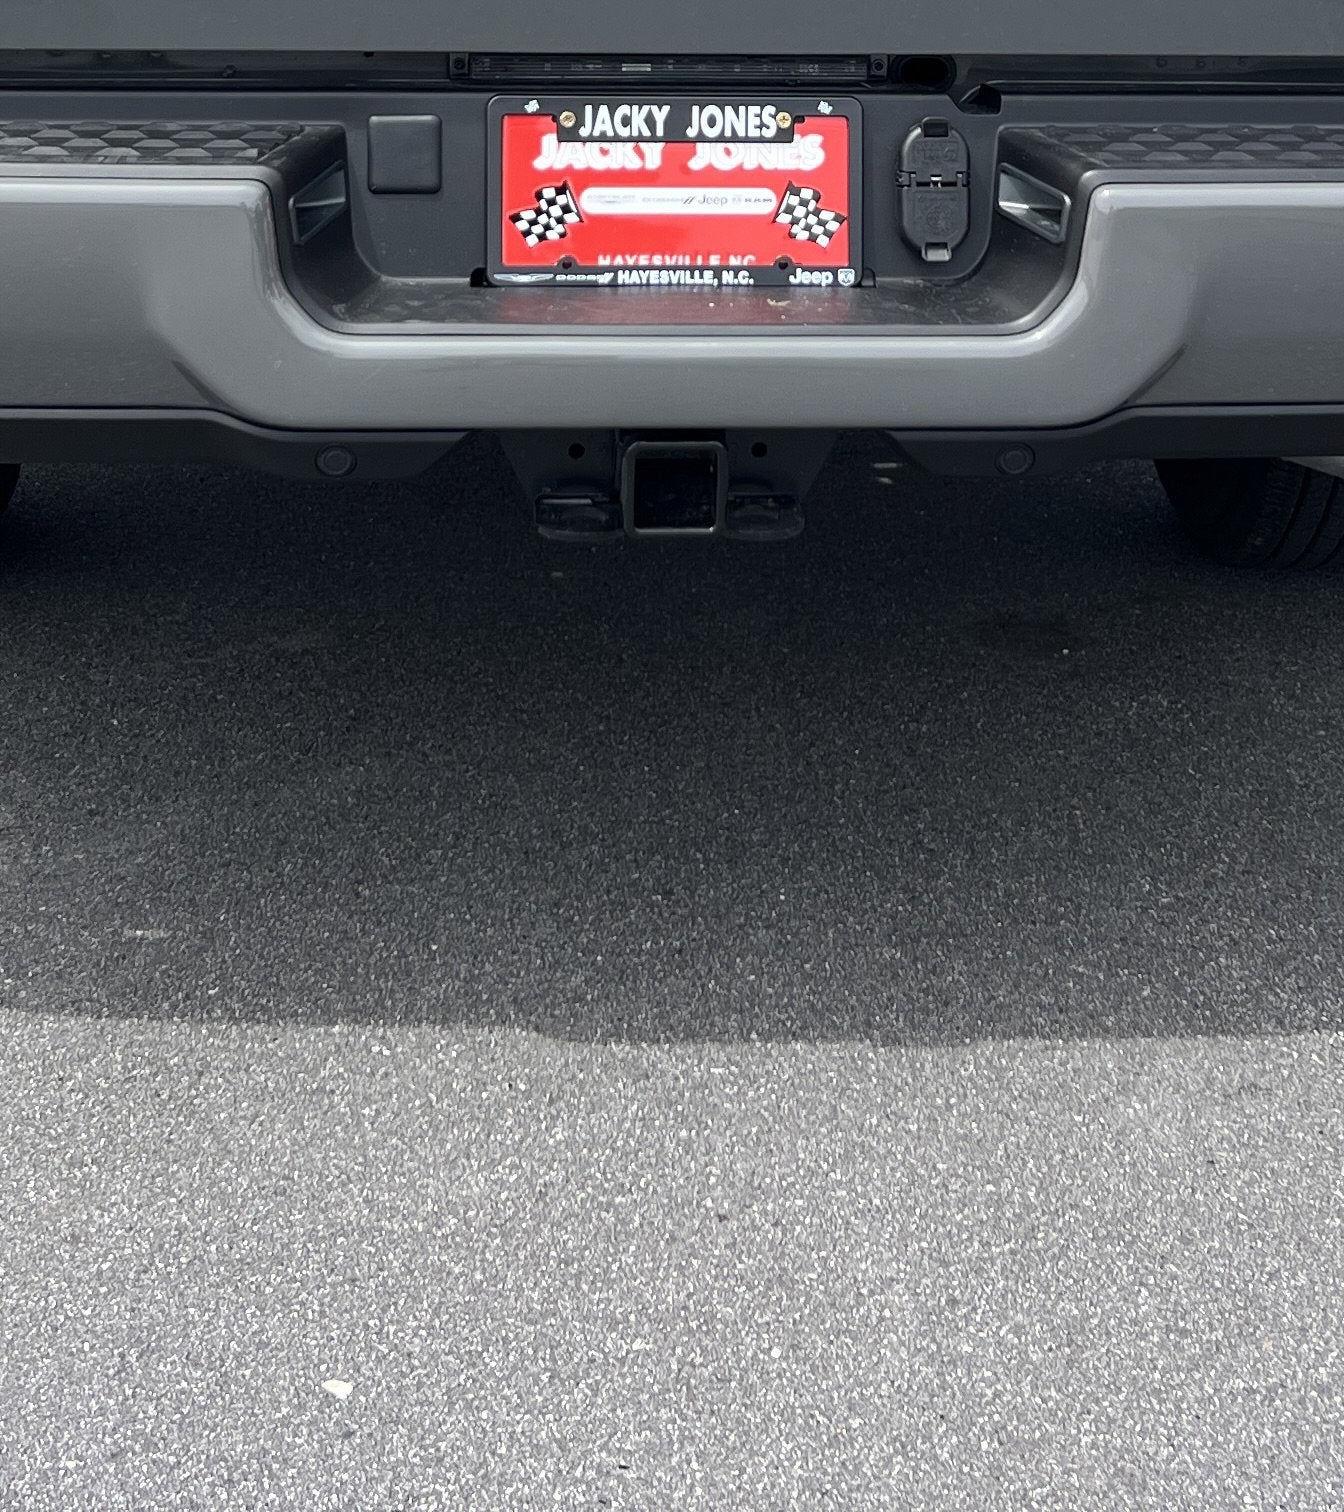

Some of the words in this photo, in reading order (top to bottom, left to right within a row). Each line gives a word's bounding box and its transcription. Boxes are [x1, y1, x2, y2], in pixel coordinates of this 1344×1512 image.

[578, 104, 670, 137] JACKY
[685, 104, 778, 137] JONES
[532, 133, 666, 171] JACKY
[687, 133, 826, 171] JONES
[698, 193, 728, 206] Jeep
[617, 269, 718, 286] HAYESVILLE,
[722, 270, 755, 285] N.C.
[789, 267, 834, 287] Jeep
